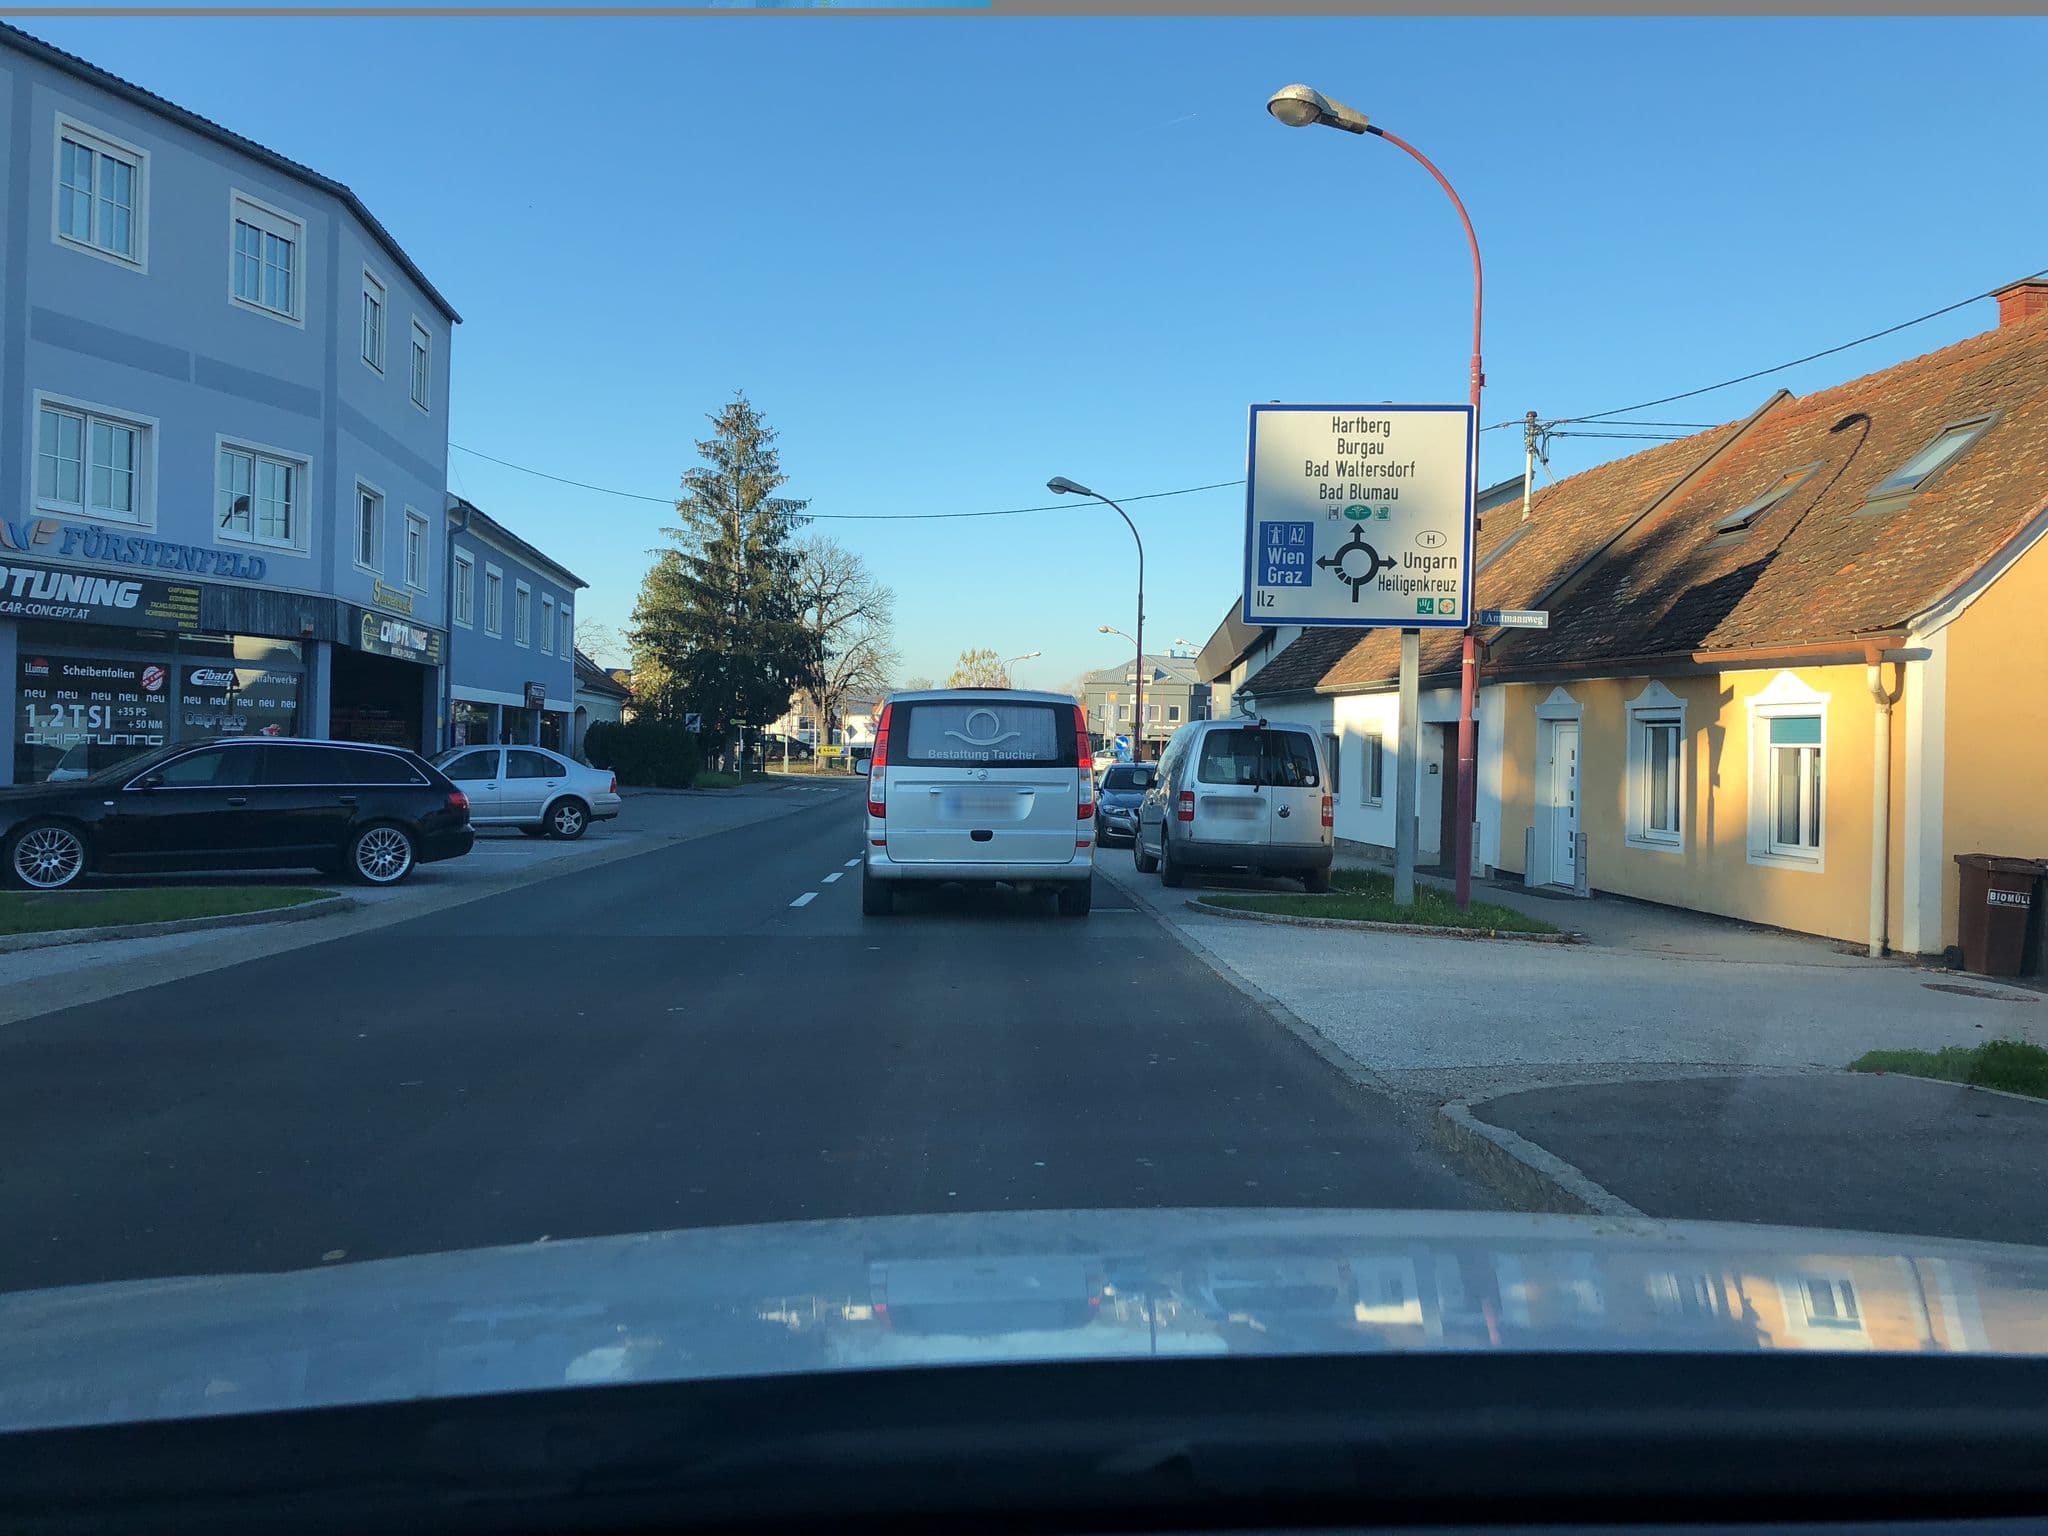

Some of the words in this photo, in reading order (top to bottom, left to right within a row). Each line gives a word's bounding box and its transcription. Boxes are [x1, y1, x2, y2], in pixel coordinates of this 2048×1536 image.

[1332, 416, 1391, 437] Hartberg
[1337, 438, 1384, 458] Burgau
[1305, 461, 1329, 477] Bad
[1335, 461, 1415, 477] Waltersdorf
[1319, 483, 1343, 500] Bad
[1350, 483, 1399, 500] Blumau
[1289, 526, 1305, 543] A2
[1426, 534, 1436, 545] H
[59, 526, 267, 580] FÜRSTENFELD
[1267, 548, 1305, 565] Wien
[1403, 552, 1457, 573] Ungarn
[1267, 567, 1303, 584] Graz
[1378, 575, 1457, 596] Heiligenkreuz
[1256, 590, 1275, 607] Ilz
[0, 601, 90, 619] CAR-CONCEPT.AT
[63, 665, 135, 679] Scheibenfolien
[190, 669, 234, 685] Eibach
[24, 688, 46, 698] neu
[57, 690, 78, 700] neu
[91, 691, 111, 701] neu
[118, 692, 138, 702] neu
[146, 694, 165, 703] neu
[183, 696, 201, 705] neu
[209, 697, 227, 706] neu
[236, 698, 253, 707] neu
[258, 699, 275, 708] neu
[280, 700, 297, 709] neu
[135, 707, 147, 717] PS
[148, 720, 163, 730] NM
[24, 733, 164, 746] CHIPTUNING
[928, 749, 989, 761] Bestattung
[993, 749, 1037, 760] Taucher
